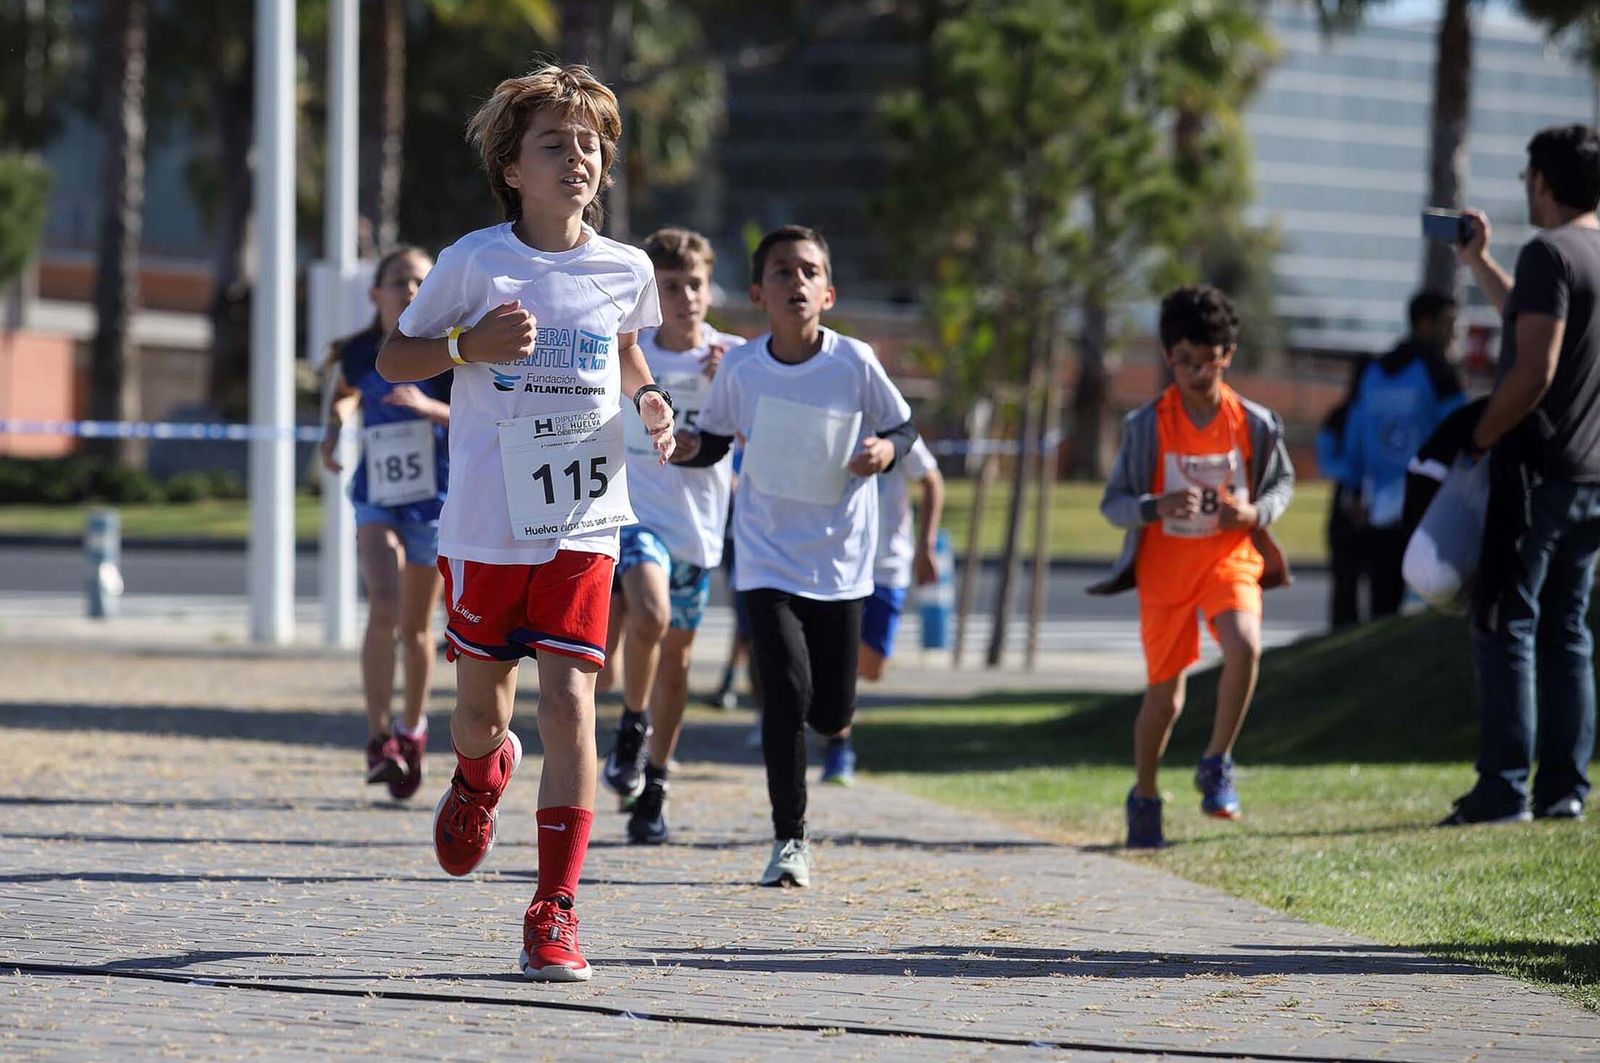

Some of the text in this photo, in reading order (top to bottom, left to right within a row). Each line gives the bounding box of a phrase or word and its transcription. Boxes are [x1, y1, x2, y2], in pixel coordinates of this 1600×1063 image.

[535, 327, 571, 346] ERA
[579, 338, 609, 354] kilos
[590, 354, 606, 370] km
[526, 373, 577, 384] Fundación
[524, 383, 606, 396] ATLANTIC COPPER
[570, 419, 601, 429] HUELVA
[373, 452, 422, 483] 185
[532, 456, 608, 505] 115
[525, 524, 558, 536] Huelva
[581, 519, 594, 528] tus
